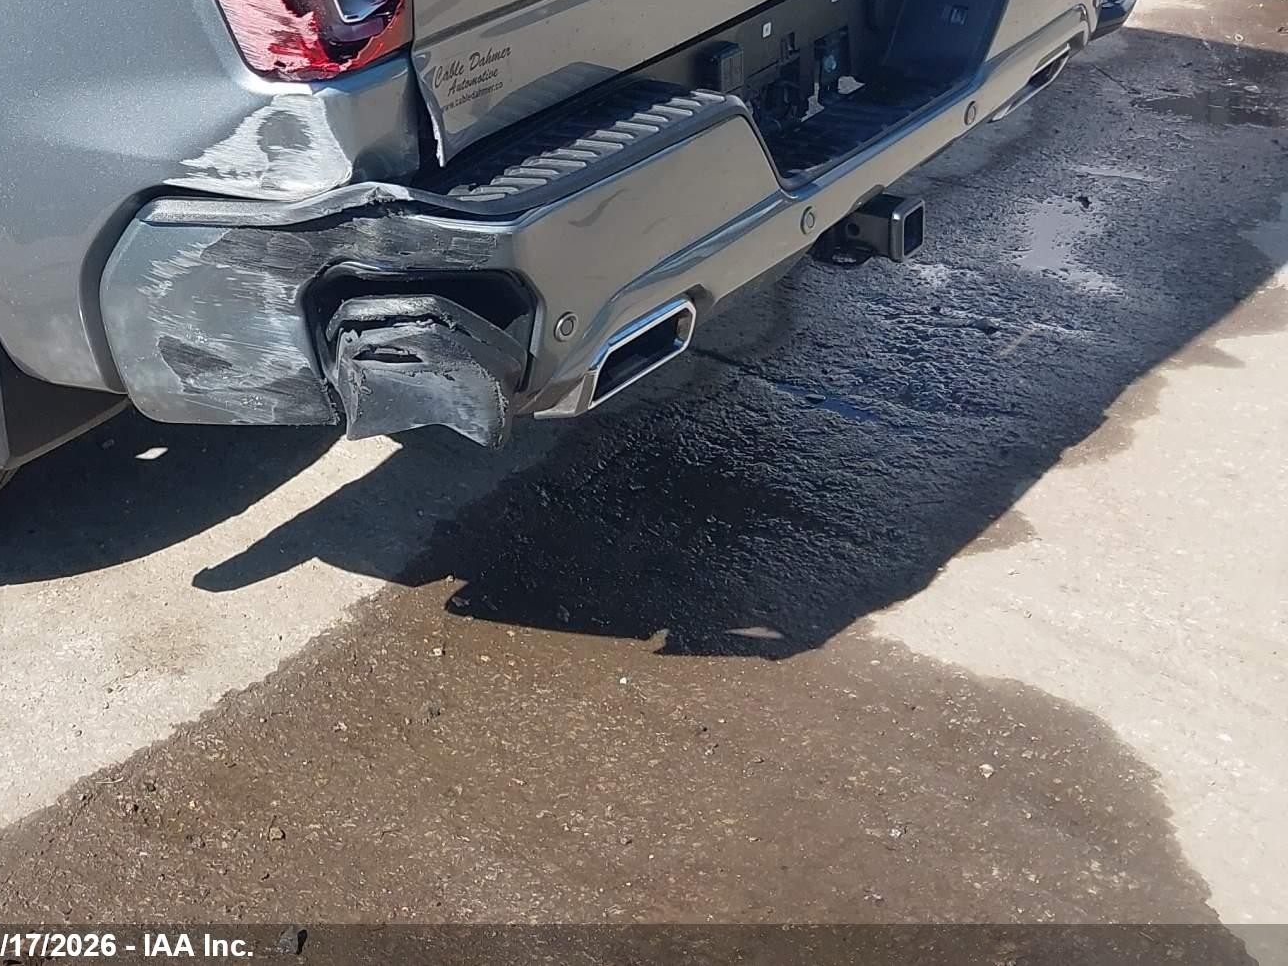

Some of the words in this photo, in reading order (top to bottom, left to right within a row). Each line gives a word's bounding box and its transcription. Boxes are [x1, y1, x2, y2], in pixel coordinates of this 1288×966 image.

[435, 60, 464, 88] Cable
[469, 46, 511, 70] Dahmer
[448, 68, 497, 96] Automotive
